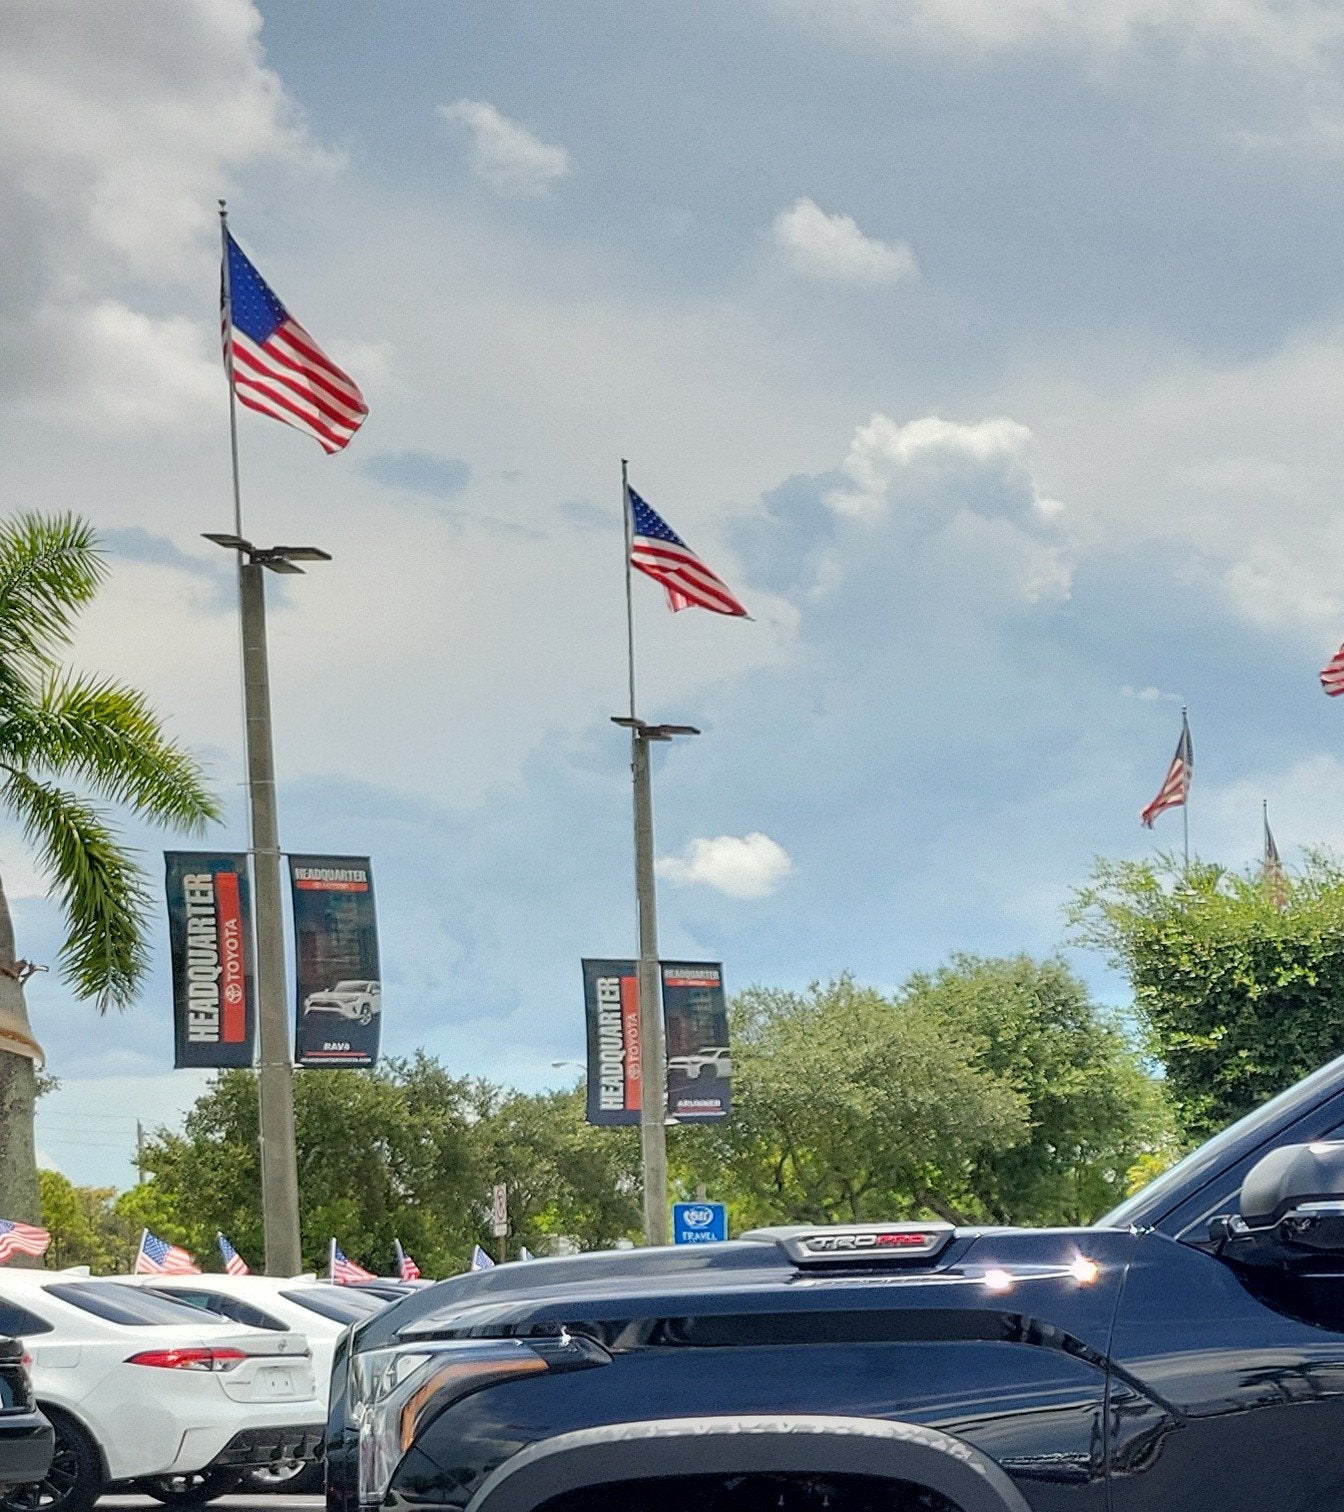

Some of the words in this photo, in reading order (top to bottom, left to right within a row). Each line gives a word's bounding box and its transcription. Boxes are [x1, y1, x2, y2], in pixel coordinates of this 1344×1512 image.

[295, 868, 367, 882] HEADQUARTER
[183, 873, 223, 1043] HEADQUARTER
[224, 918, 242, 983] TOYOTA
[323, 1042, 351, 1051] RAV4
[596, 976, 627, 1111] HEADQUARTER
[627, 1013, 640, 1056] TOYOTA
[875, 1233, 925, 1246] PRO
